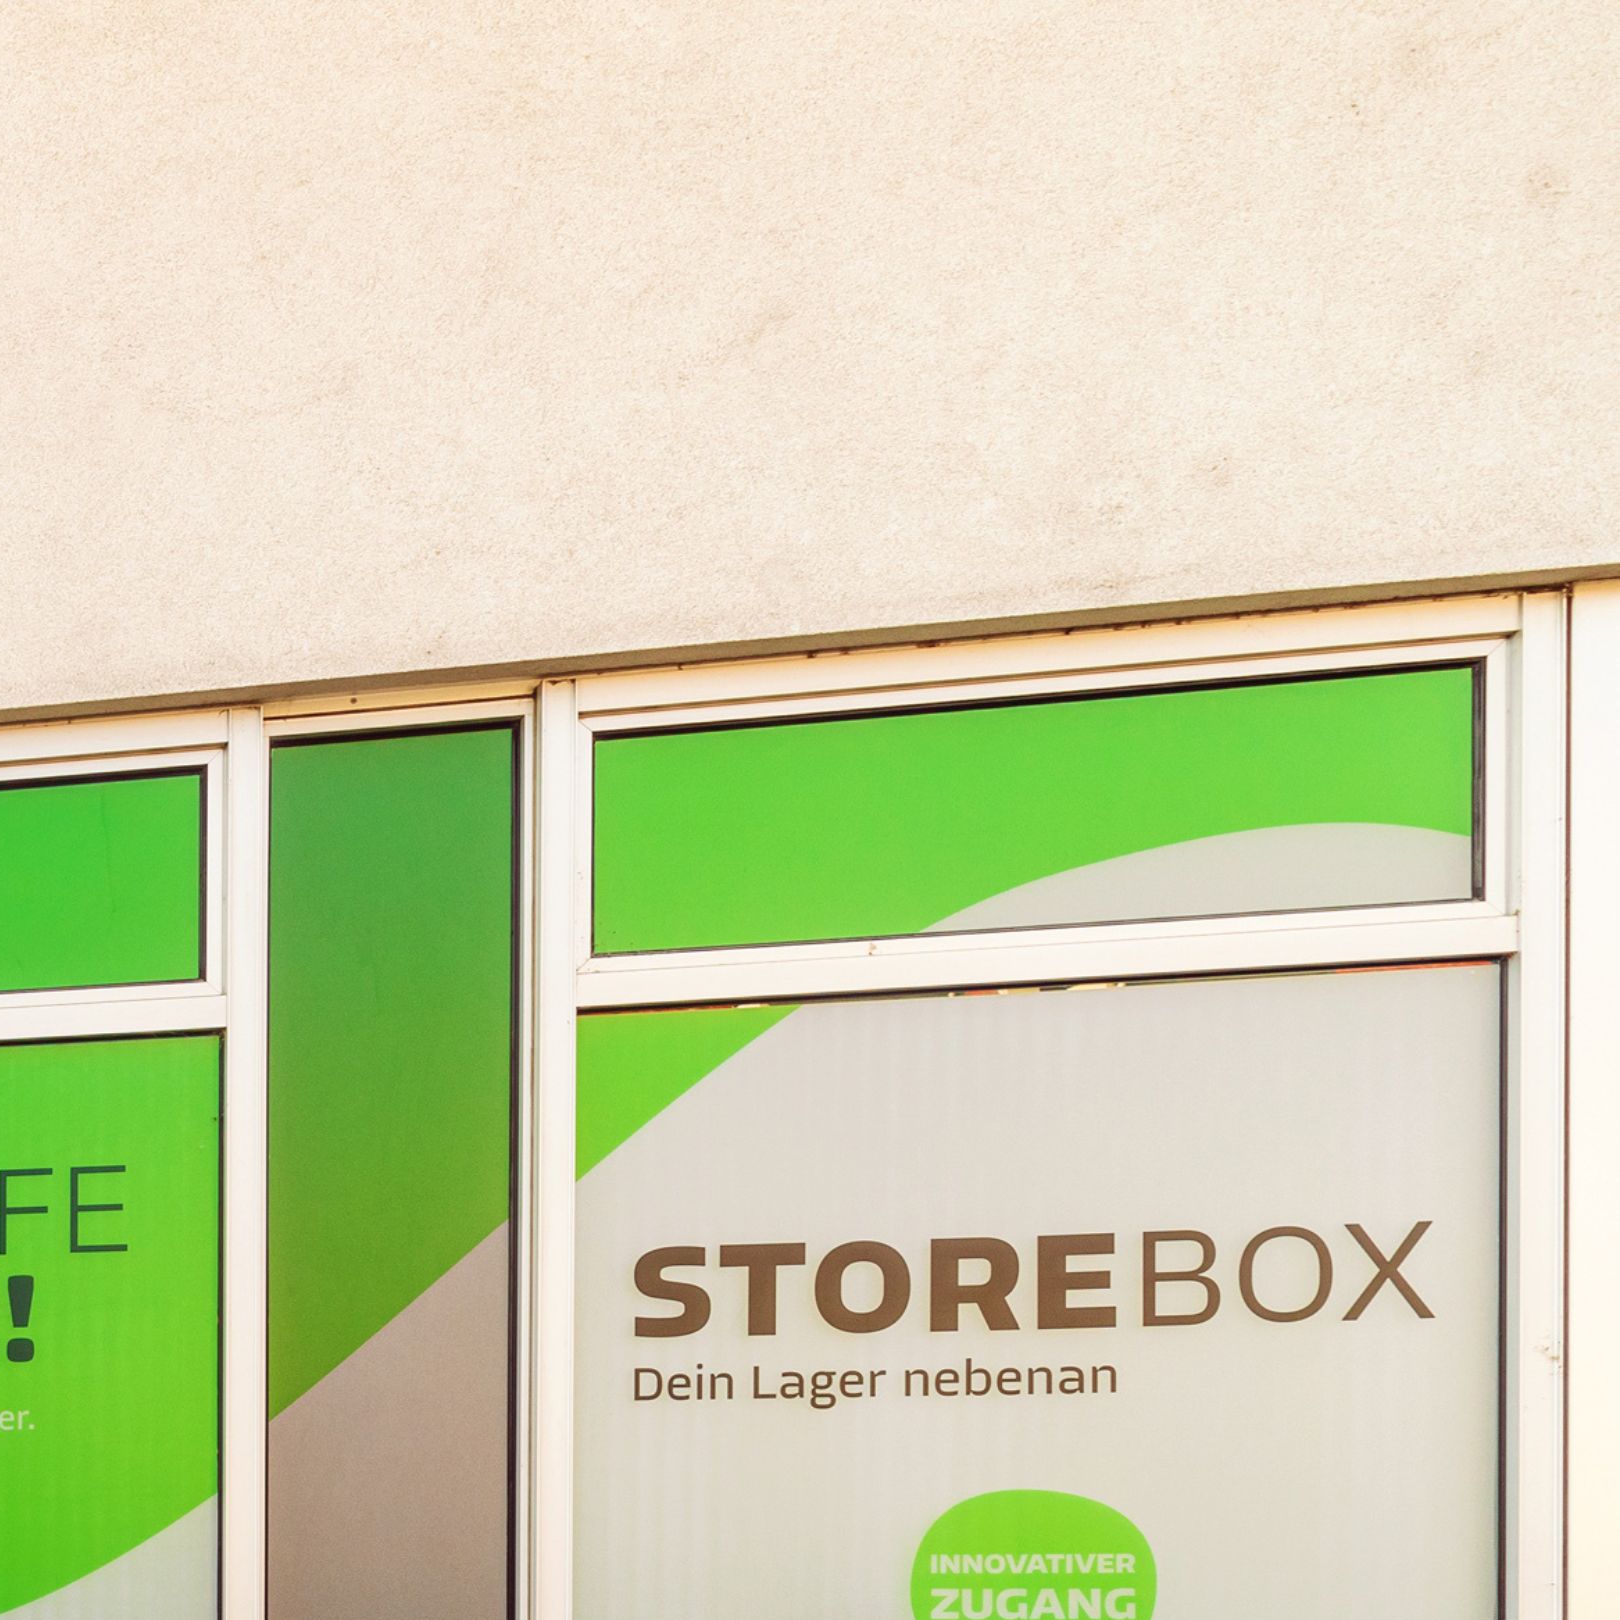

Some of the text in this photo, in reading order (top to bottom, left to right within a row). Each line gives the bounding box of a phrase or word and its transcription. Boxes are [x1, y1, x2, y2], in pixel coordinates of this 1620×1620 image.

[633, 1220, 1436, 1338] STOREBOX
[633, 1358, 1119, 1410] Dein Lager nebenan
[929, 1553, 1137, 1576] INNOVATIVER
